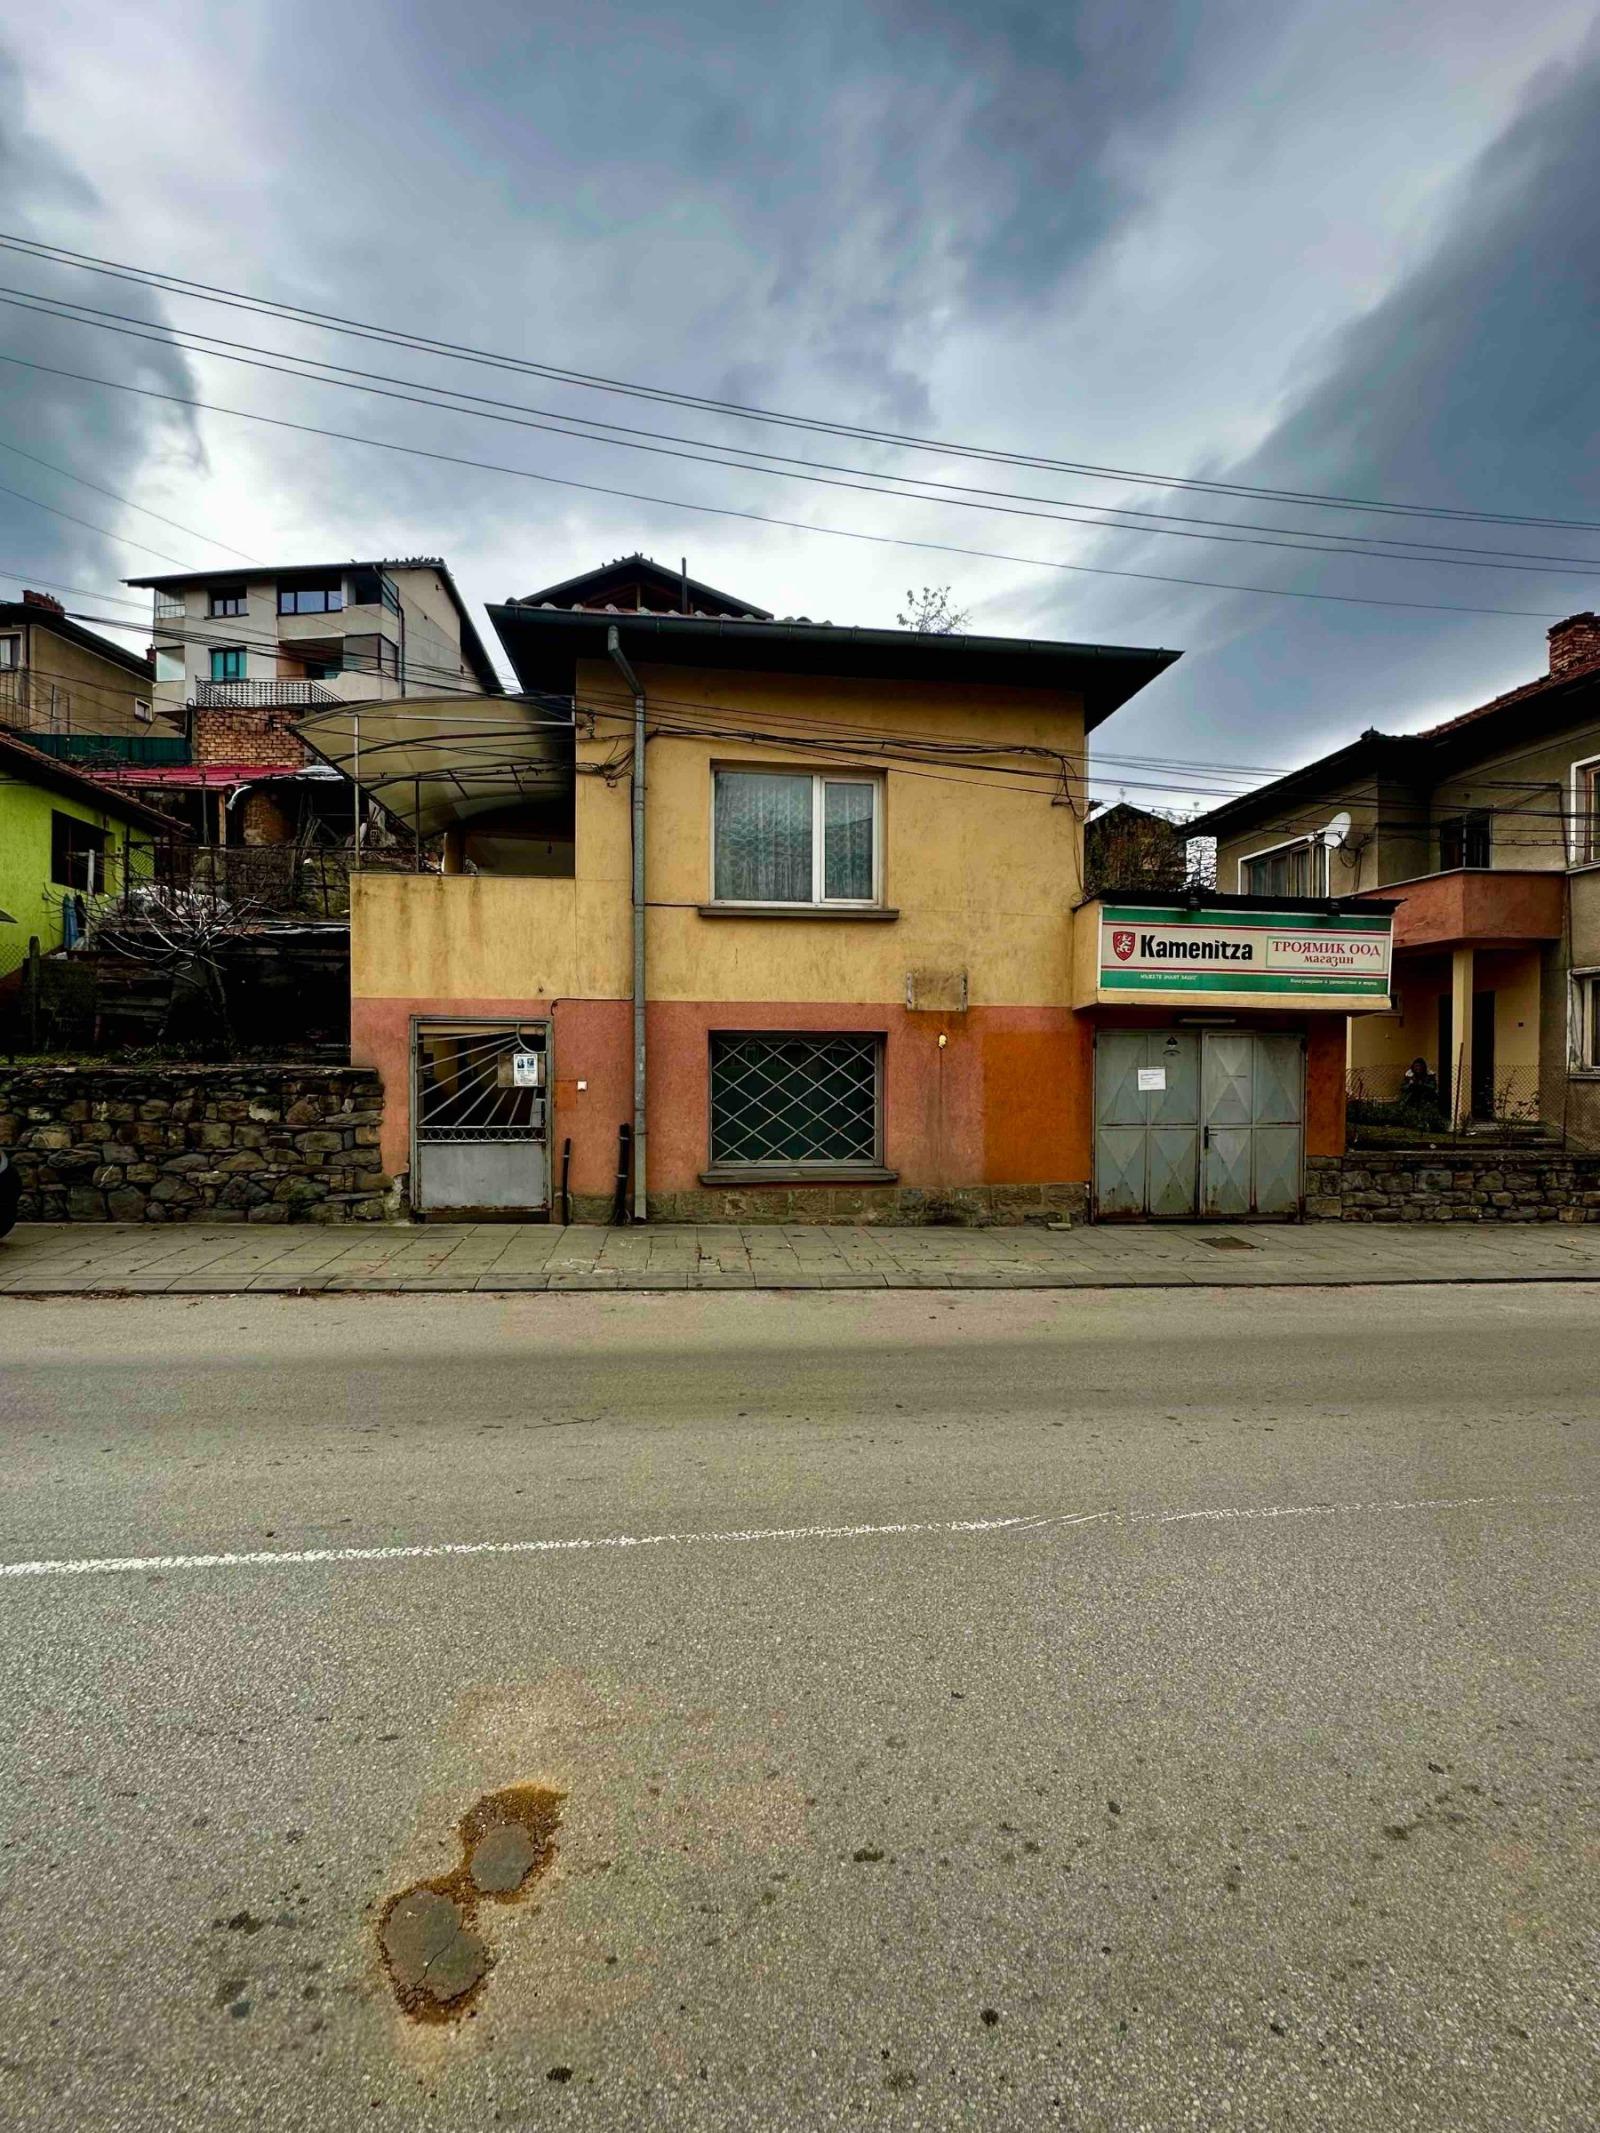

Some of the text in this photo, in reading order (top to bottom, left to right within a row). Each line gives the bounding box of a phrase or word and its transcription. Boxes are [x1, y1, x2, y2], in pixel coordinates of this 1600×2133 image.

[1140, 934, 1253, 960] Kamenitza
[1272, 940, 1381, 956] ТРОЯМИК ООД
[1303, 954, 1354, 967] магазин
